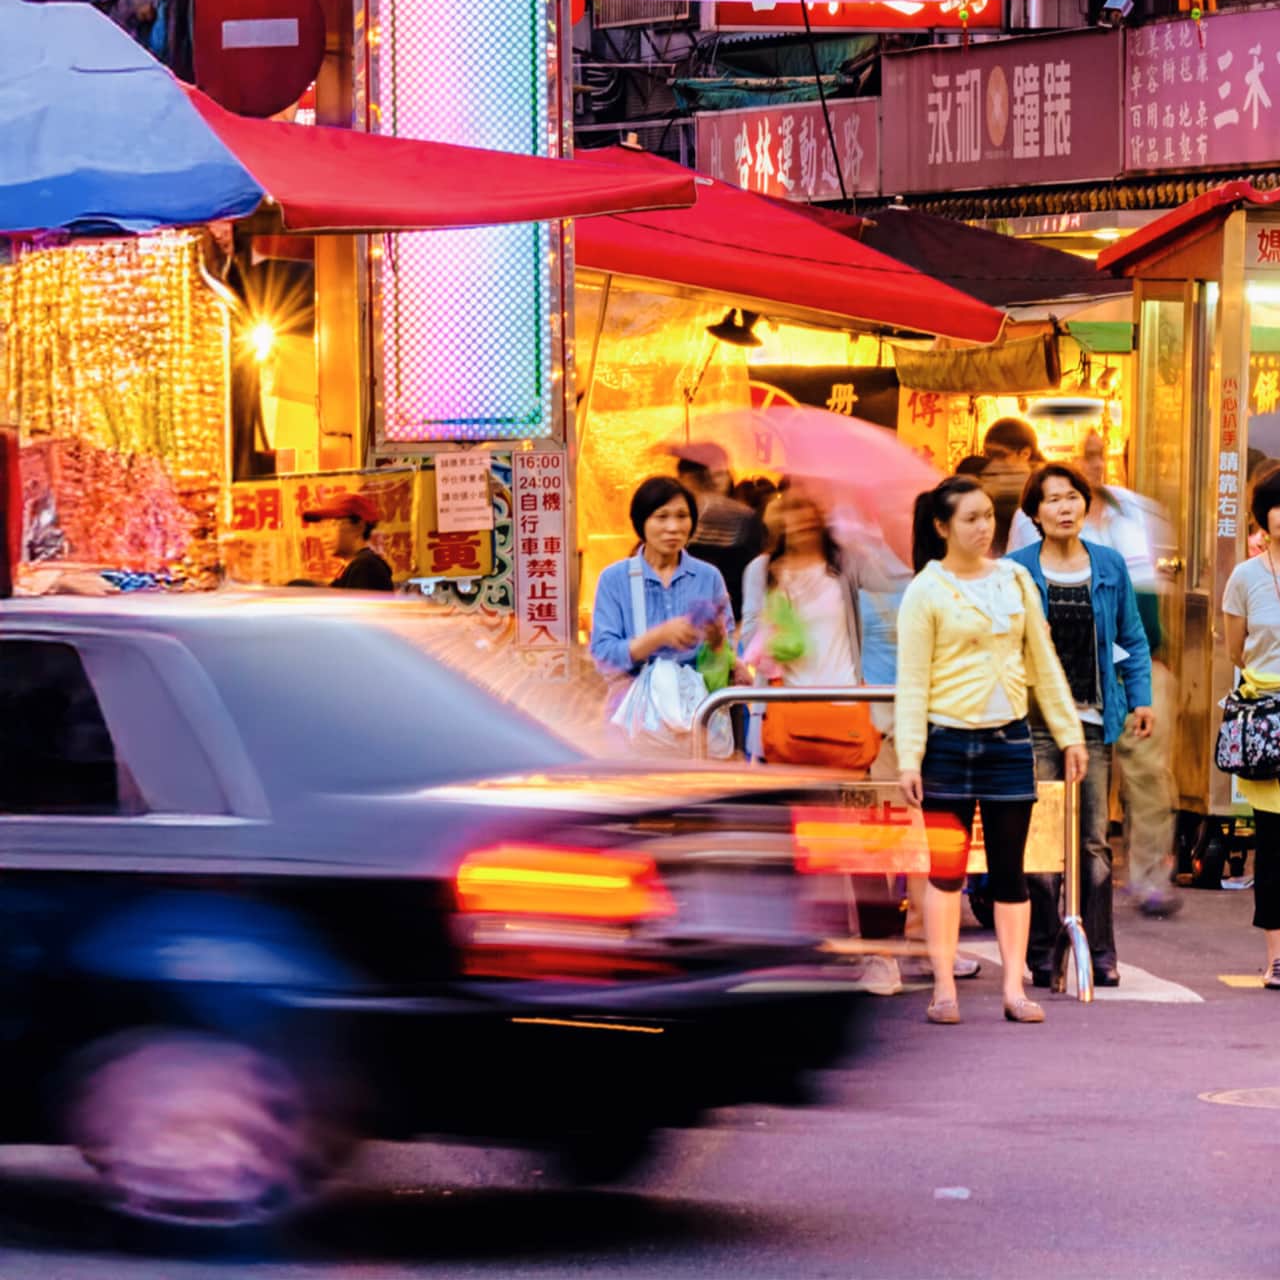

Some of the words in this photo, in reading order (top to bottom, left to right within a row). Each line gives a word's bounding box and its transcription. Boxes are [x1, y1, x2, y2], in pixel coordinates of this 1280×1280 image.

[519, 456, 560, 469] 16:00
[519, 476, 561, 489] 24:00
[526, 559, 558, 644] 禁止進入
